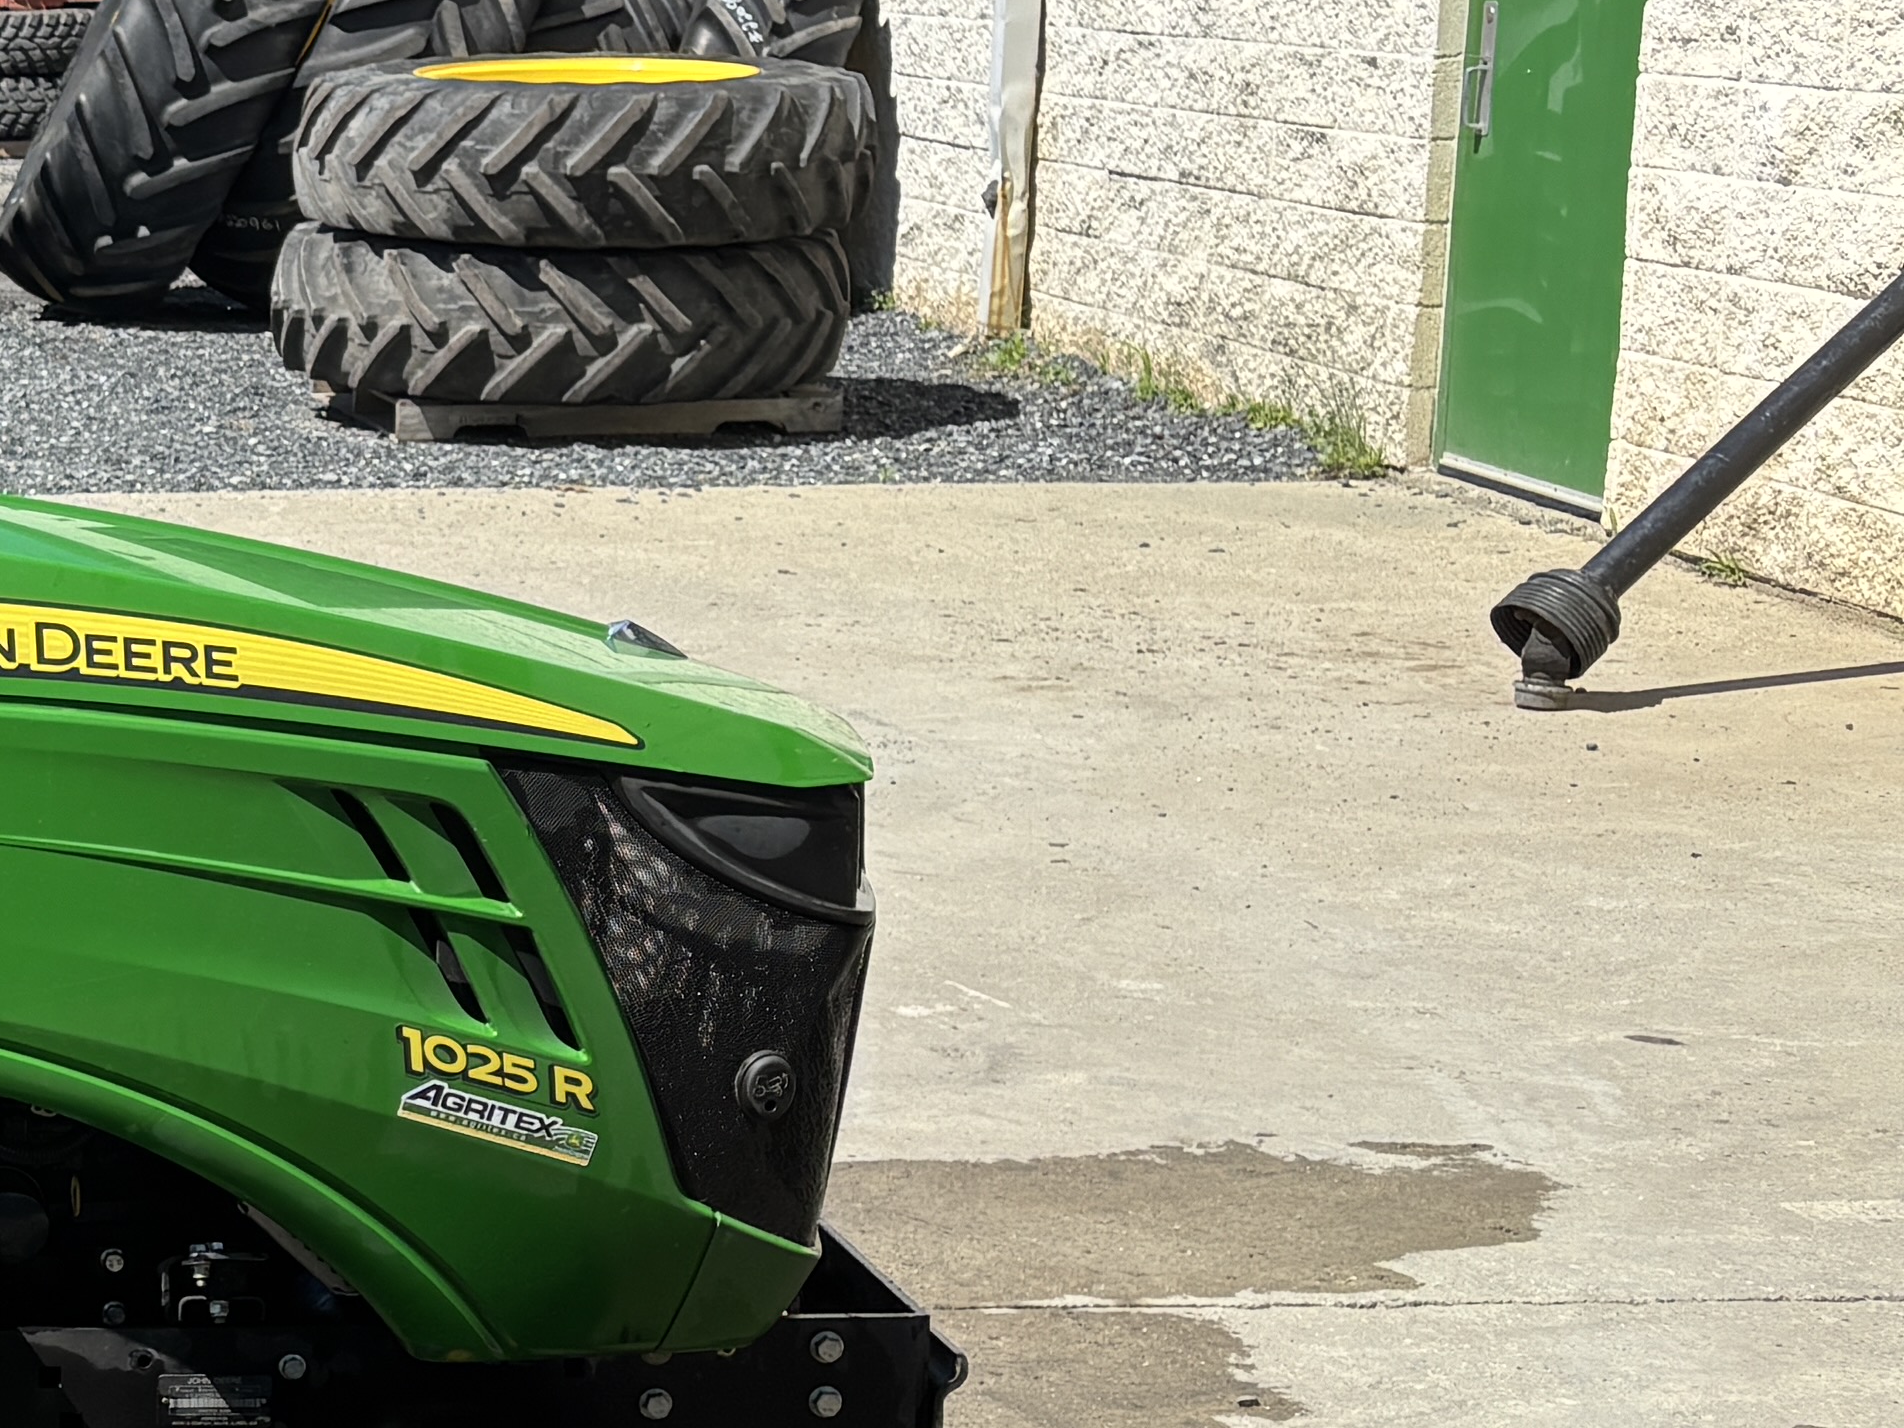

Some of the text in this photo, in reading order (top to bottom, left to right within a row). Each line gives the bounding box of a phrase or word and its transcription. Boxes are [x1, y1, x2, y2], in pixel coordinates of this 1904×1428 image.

[34, 620, 241, 682] DEERE
[400, 1025, 595, 1113] 1025 R
[405, 1083, 560, 1139] AGRITEX
